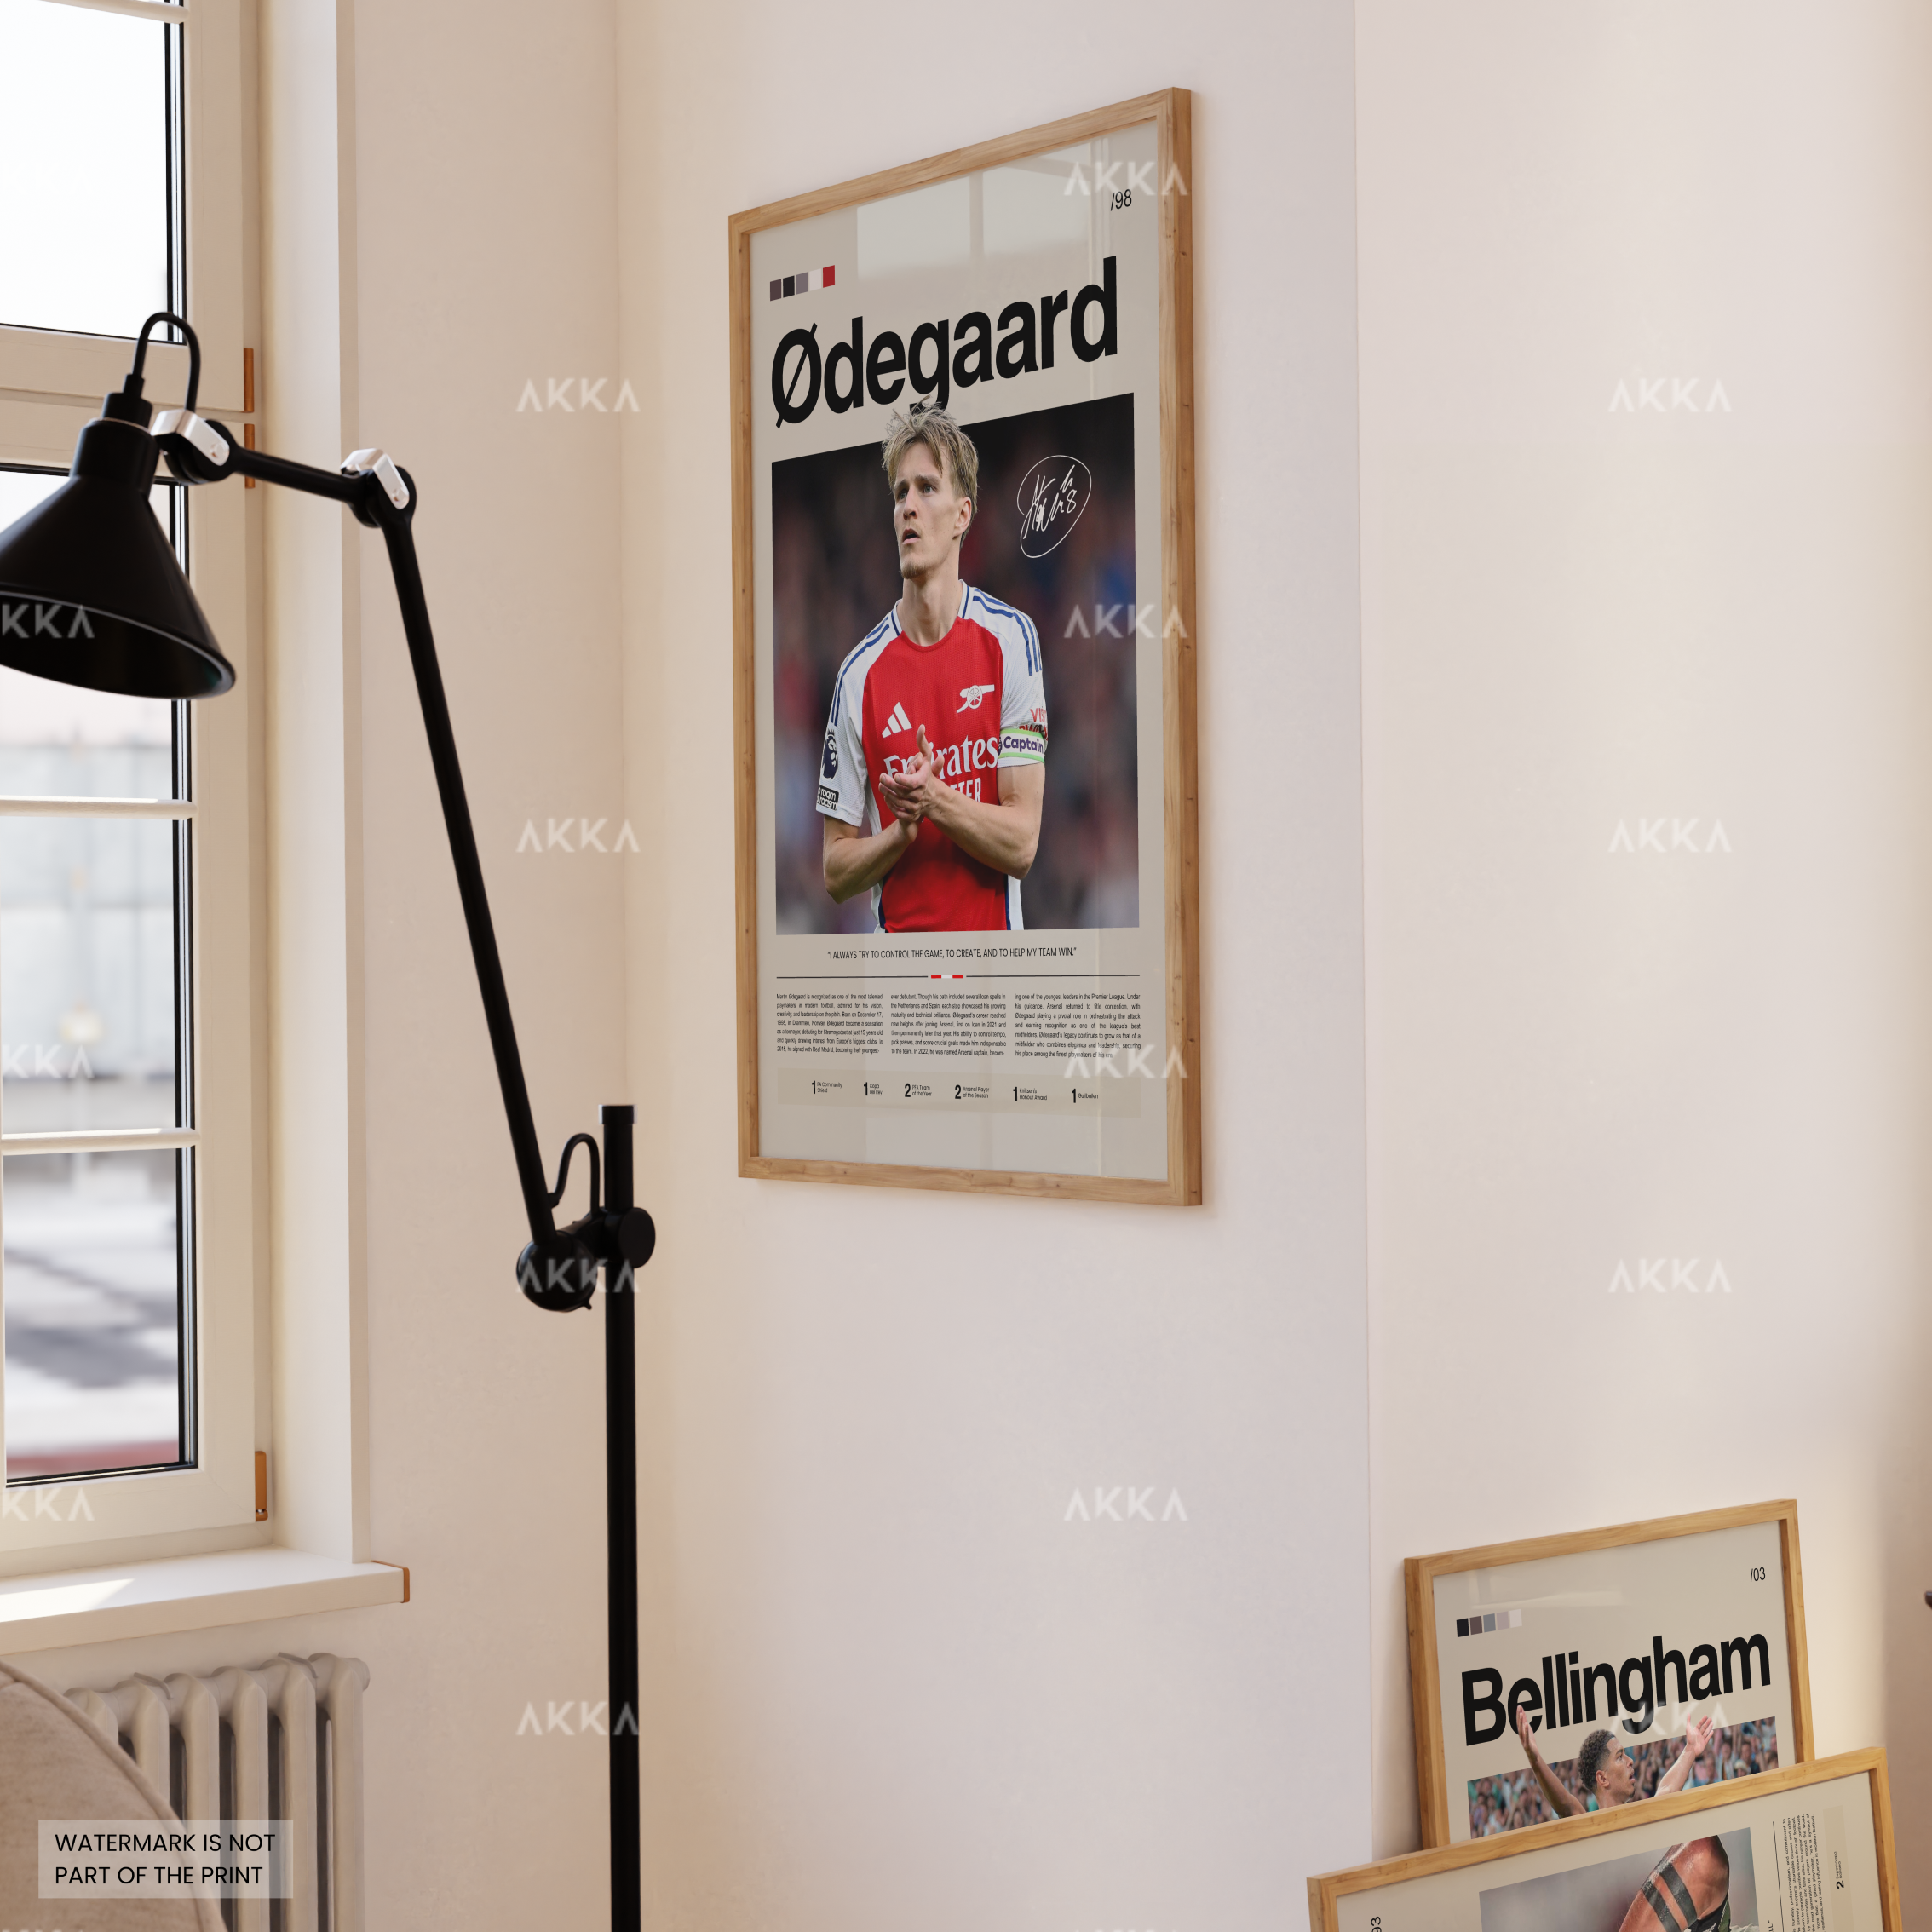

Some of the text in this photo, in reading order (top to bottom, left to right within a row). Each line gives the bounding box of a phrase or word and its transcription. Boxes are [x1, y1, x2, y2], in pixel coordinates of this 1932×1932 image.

[1111, 189, 1132, 211] /98
[771, 256, 1118, 428] Ødegaard
[1003, 736, 1044, 755] Captain
[833, 951, 858, 959] ALWAYS
[881, 950, 910, 958] CONTROL
[946, 949, 954, 957] TO
[999, 948, 1008, 957] TO
[1009, 948, 1025, 957] HELP
[1026, 948, 1037, 957] MY
[812, 1080, 815, 1094] 1
[864, 1082, 867, 1095] 1
[905, 1083, 911, 1097] 2
[955, 1084, 961, 1099] 2
[1013, 1087, 1018, 1101] 1
[1071, 1089, 1076, 1103] 1
[1750, 1567, 1766, 1584] /03
[1461, 1632, 1772, 1746] Bellingham
[1836, 1880, 1844, 1889] 2
